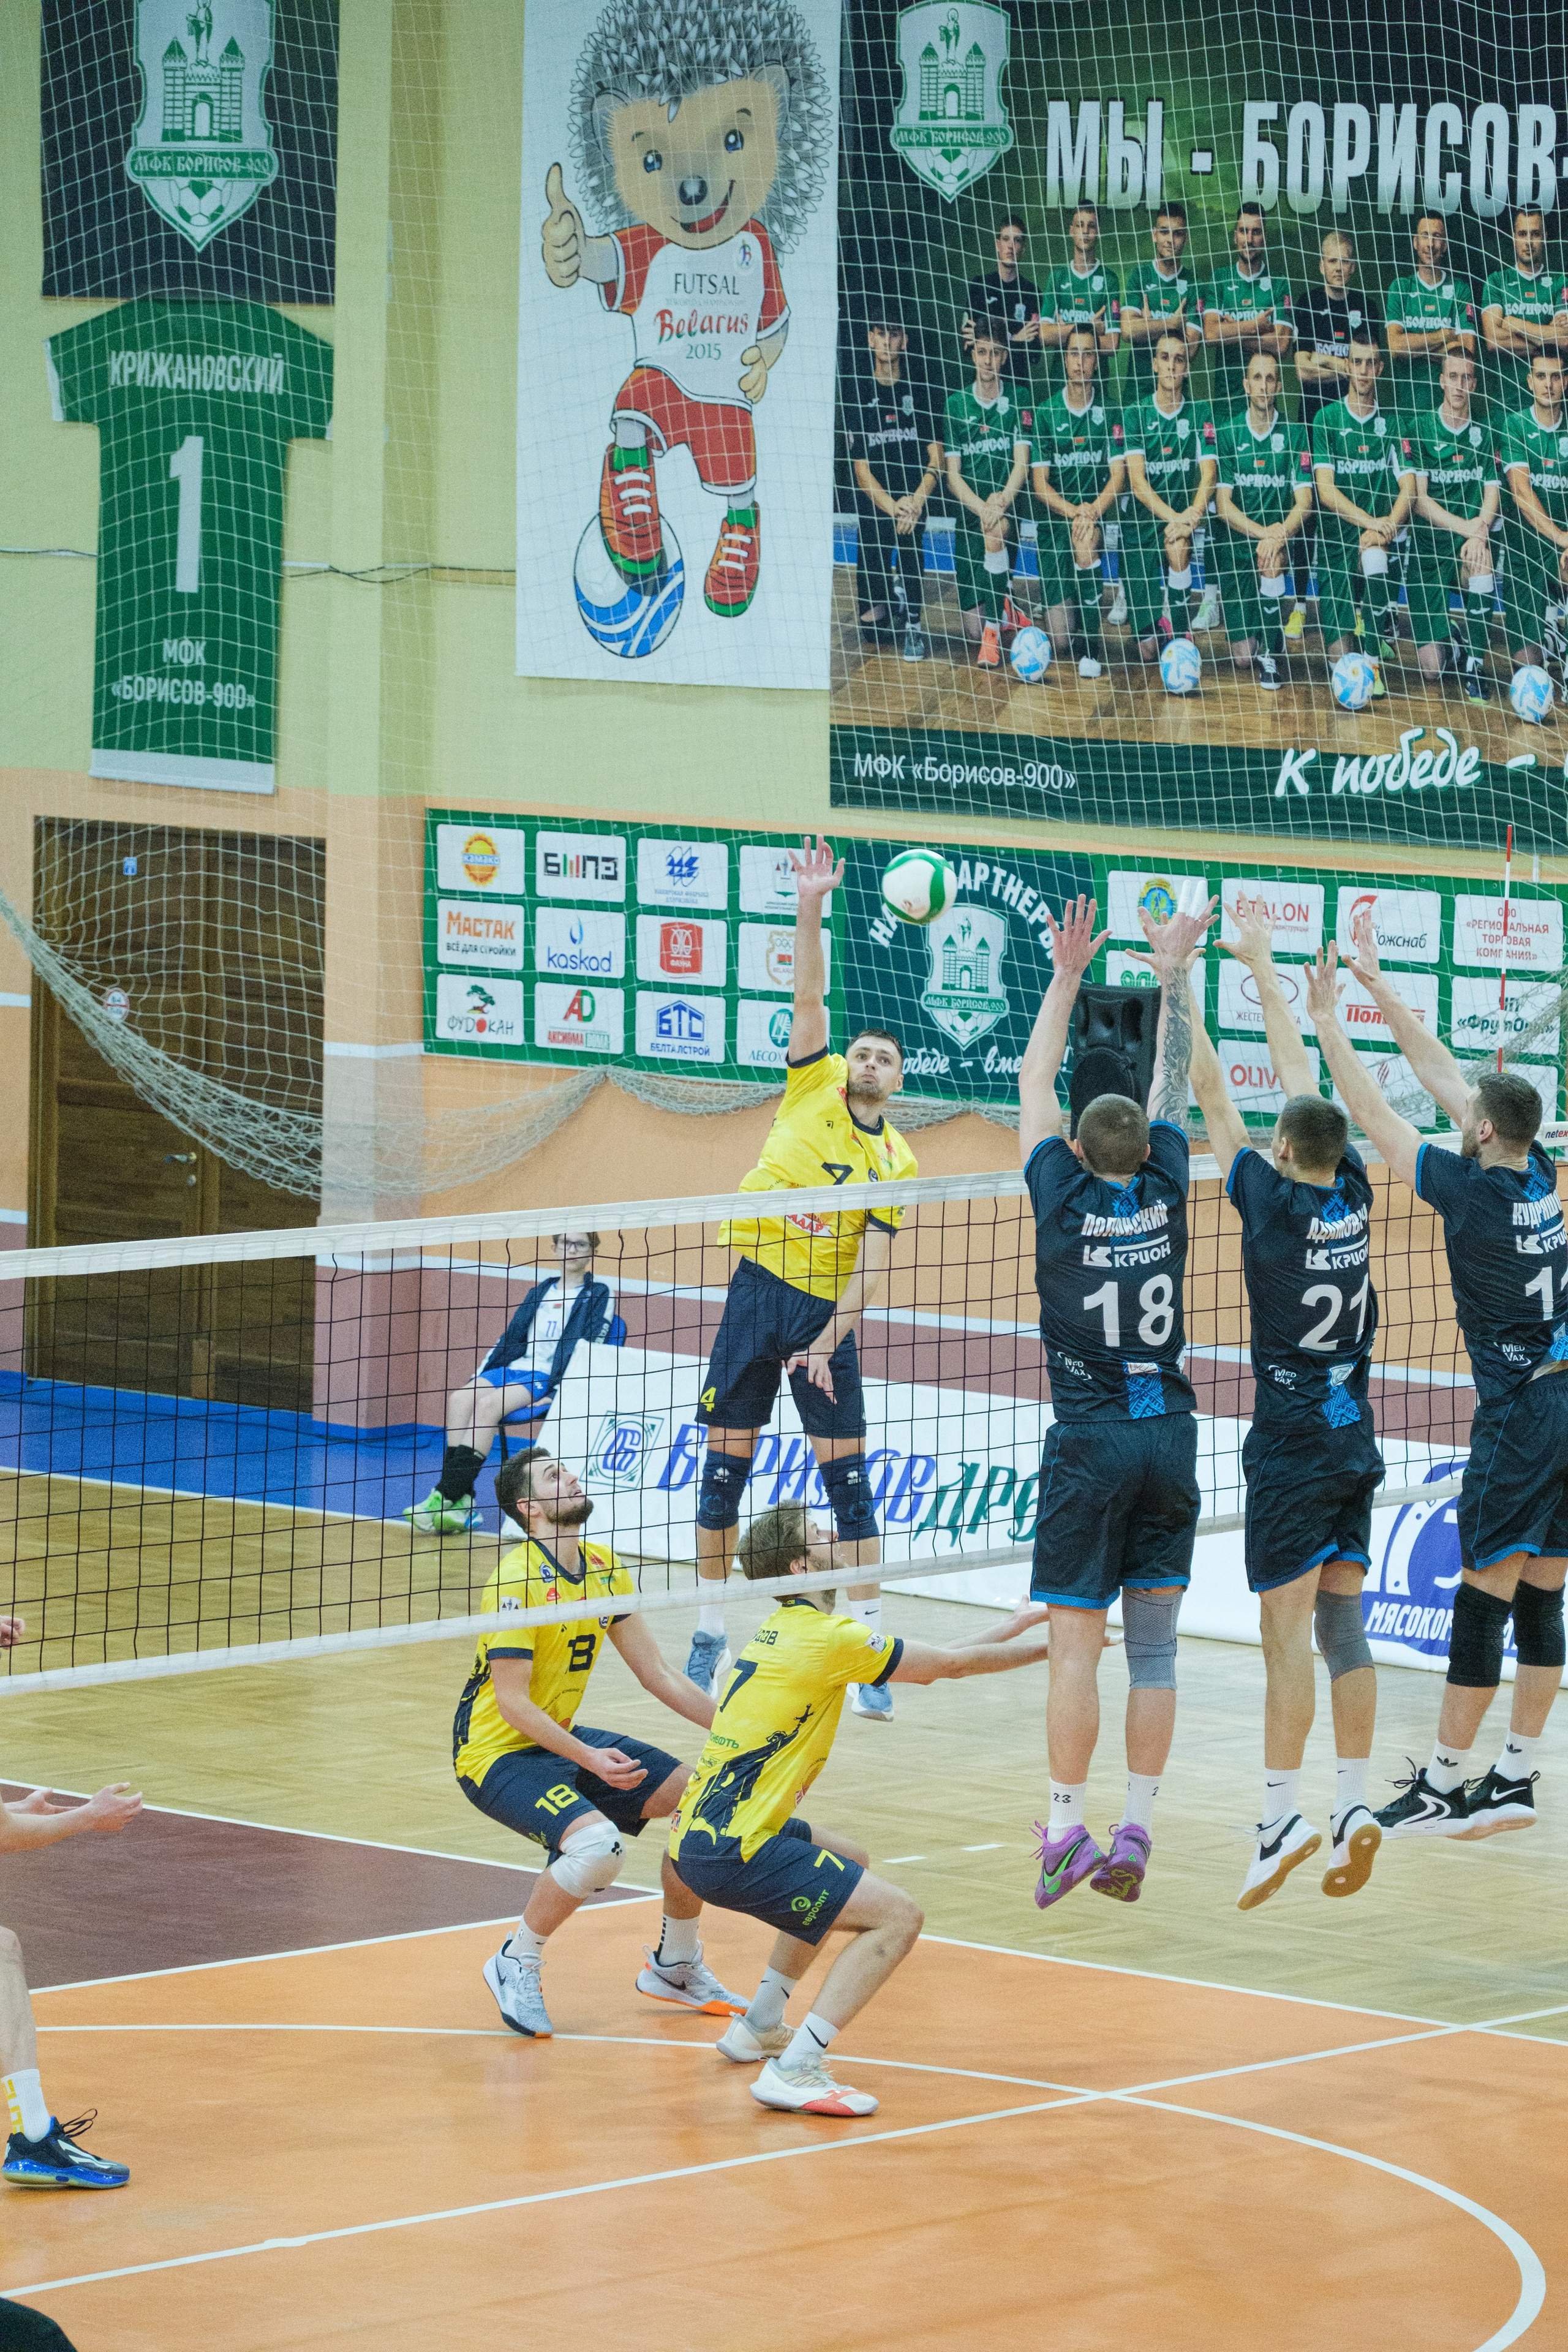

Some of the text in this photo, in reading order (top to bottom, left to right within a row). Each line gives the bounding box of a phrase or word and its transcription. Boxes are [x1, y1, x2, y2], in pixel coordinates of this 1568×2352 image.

[897, 130, 927, 144] МФК
[134, 154, 173, 172] МФК
[1046, 100, 1163, 209] МЫ
[1242, 101, 1568, 217] БОРИСОВ
[674, 273, 739, 295] FUTSAL
[654, 309, 748, 345] Belarus
[685, 343, 722, 361] 2015
[110, 350, 284, 396] КРИЖАНОВСКИЙ
[170, 435, 203, 592] 1
[162, 639, 206, 666] МФК
[111, 675, 256, 710] «БОРИСОВ-900»
[854, 753, 1076, 790] МФК «Борисов-900»
[1275, 747, 1318, 797] К
[1332, 727, 1482, 795] победе
[948, 859, 1060, 960] АРТНЕРЫ
[1466, 919, 1549, 934] «РЕГИОАЛЬНАЯ
[548, 947, 612, 973] kaskad
[902, 1048, 949, 1075] обеде
[1230, 1064, 1285, 1090] OLIV
[1526, 1265, 1568, 1321] 1
[1084, 1273, 1175, 1347] 18
[1298, 1272, 1369, 1351] 21
[700, 1387, 717, 1412] 4
[719, 1659, 758, 1713] 7
[535, 1784, 579, 1817] 18
[1054, 1793, 1072, 1804] 23
[813, 1849, 846, 1872] 7
